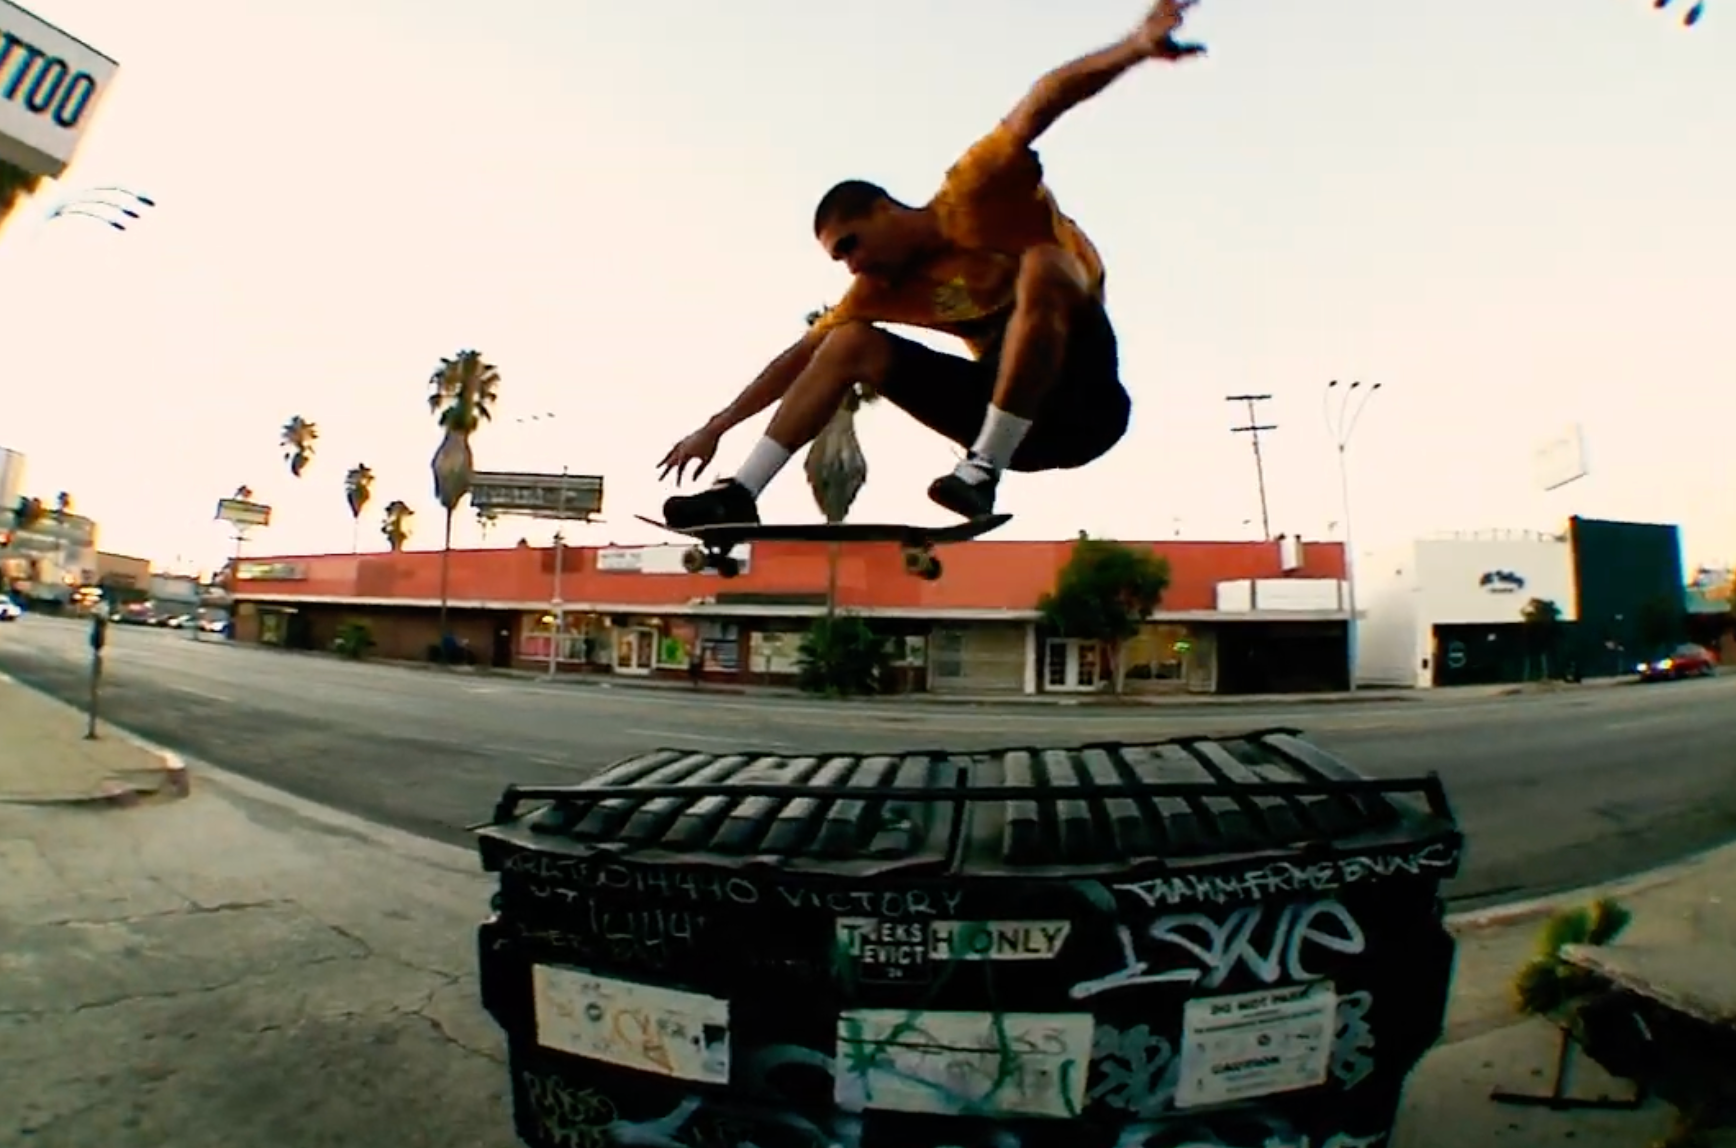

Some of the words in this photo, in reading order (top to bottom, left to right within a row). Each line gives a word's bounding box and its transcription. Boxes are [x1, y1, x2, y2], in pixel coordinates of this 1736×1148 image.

[777, 885, 963, 917] VICTORY
[861, 943, 926, 965] EVICT
[971, 925, 1065, 955] ONLY
